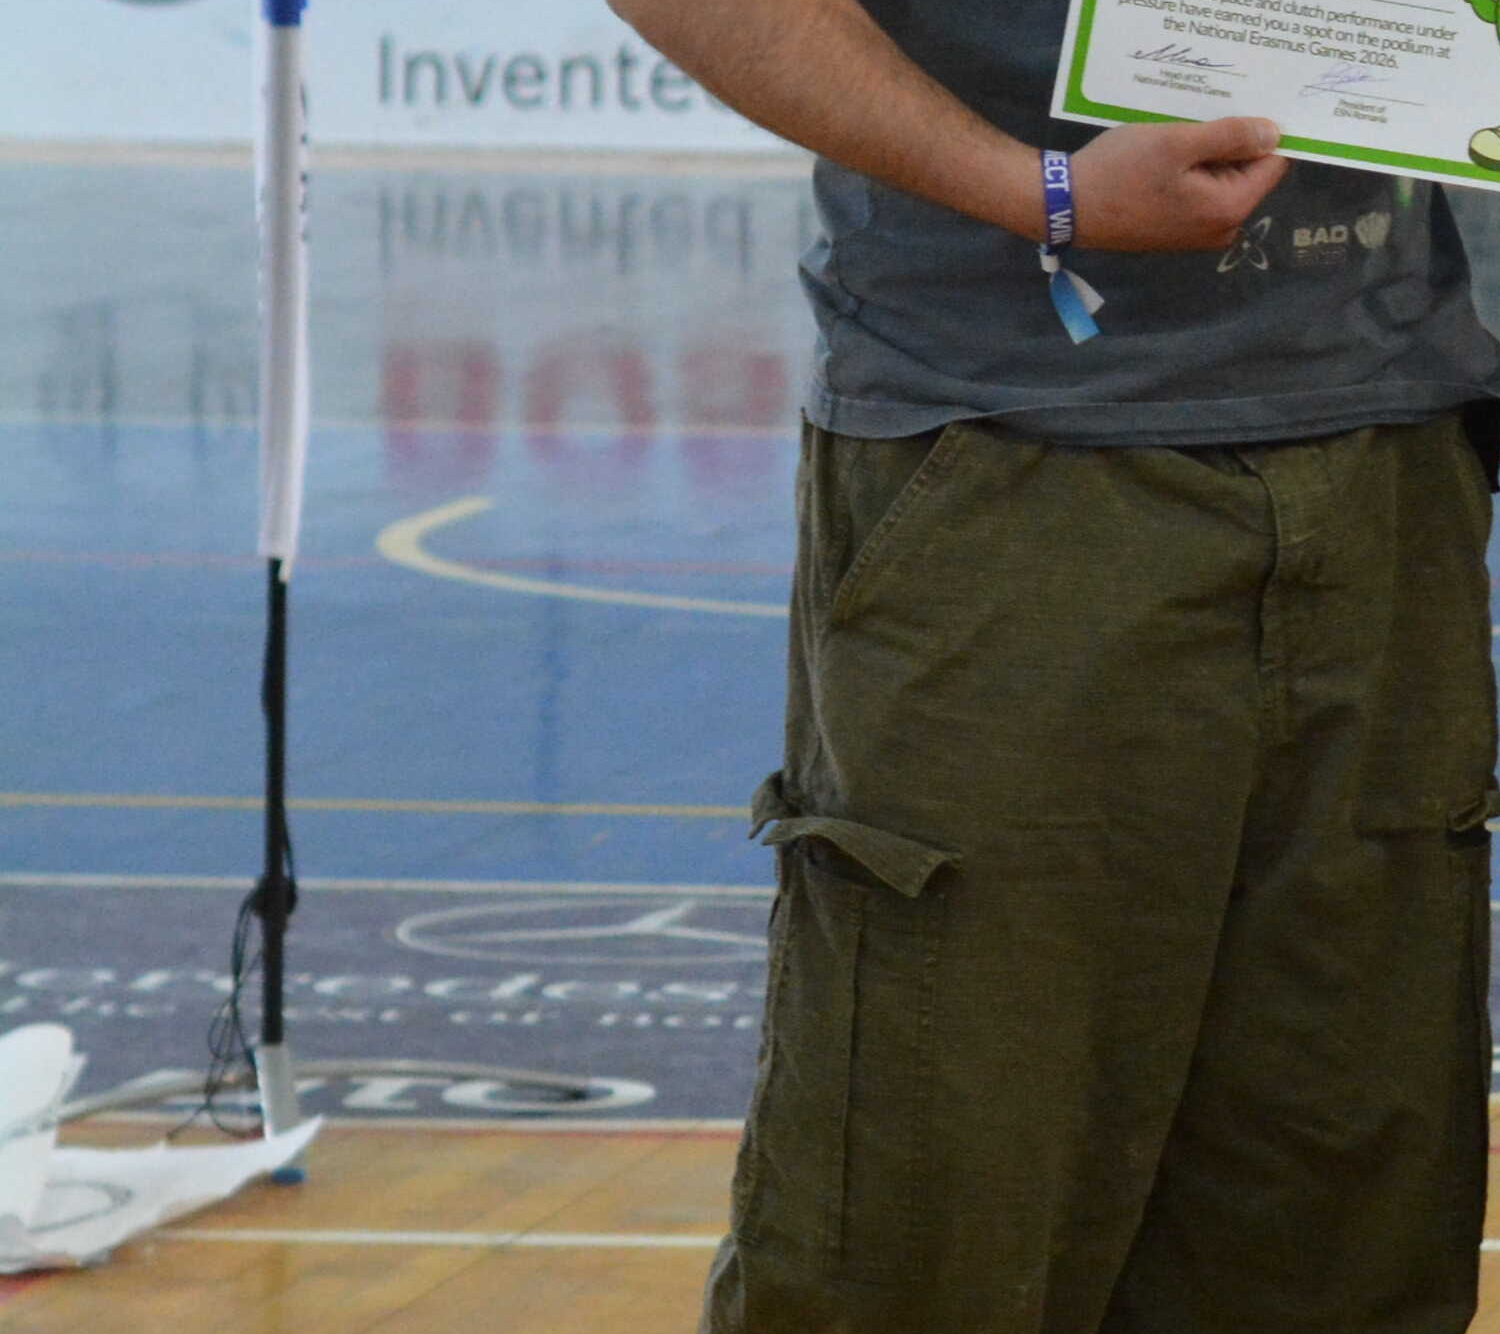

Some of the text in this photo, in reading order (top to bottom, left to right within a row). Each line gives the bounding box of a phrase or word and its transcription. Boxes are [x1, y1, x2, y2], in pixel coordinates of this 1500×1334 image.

[1162, 15, 1187, 33] the
[1187, 19, 1248, 43] National
[1248, 29, 1306, 54] Erasmus
[1307, 40, 1357, 62] Games
[1178, 0, 1213, 19] have
[1212, 8, 1263, 27] earned
[1262, 17, 1290, 32] you
[1290, 21, 1301, 35] a
[1301, 24, 1335, 40] spot
[1334, 29, 1355, 44] on
[1355, 30, 1380, 48] the
[1379, 37, 1435, 56] podium
[1434, 46, 1451, 60] at
[1282, 0, 1325, 20] clutch
[1325, 10, 1415, 35] performance
[1415, 25, 1458, 41] under
[378, 34, 725, 111] Invente
[1044, 150, 1070, 192] ECT
